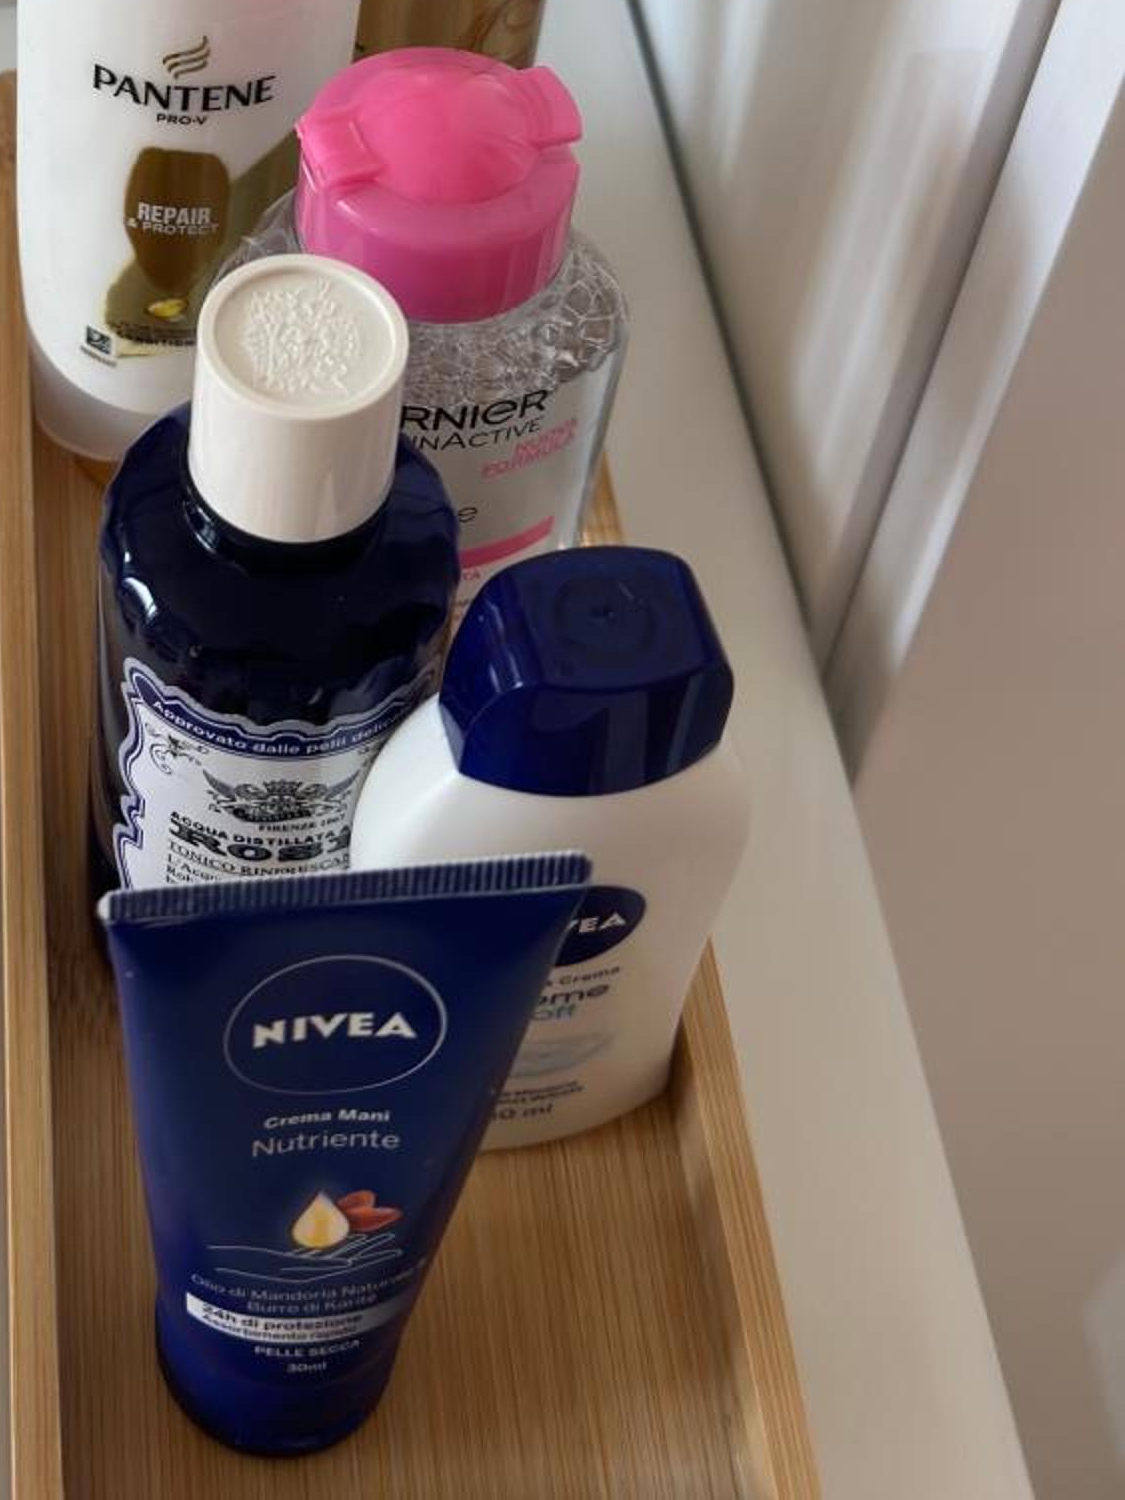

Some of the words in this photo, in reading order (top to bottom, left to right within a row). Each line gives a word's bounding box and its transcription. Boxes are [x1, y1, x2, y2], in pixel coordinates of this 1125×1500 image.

[92, 63, 277, 112] PANTENE
[156, 113, 207, 125] PRO-V
[138, 202, 212, 225] REPAIR
[153, 700, 248, 750] Approvato
[252, 741, 301, 755] dalle
[170, 811, 228, 840] ACQUA
[232, 829, 336, 847] DISTILLATA
[169, 840, 236, 875] TONICO
[252, 1011, 418, 1049] NIVEA
[264, 1110, 332, 1130] Crema
[338, 1108, 391, 1122] Mani
[252, 1129, 401, 1158] Nutriente
[202, 1301, 237, 1323] 24h
[240, 1312, 259, 1327] di
[263, 1314, 364, 1333] protezione
[254, 1345, 304, 1358] PELLE
